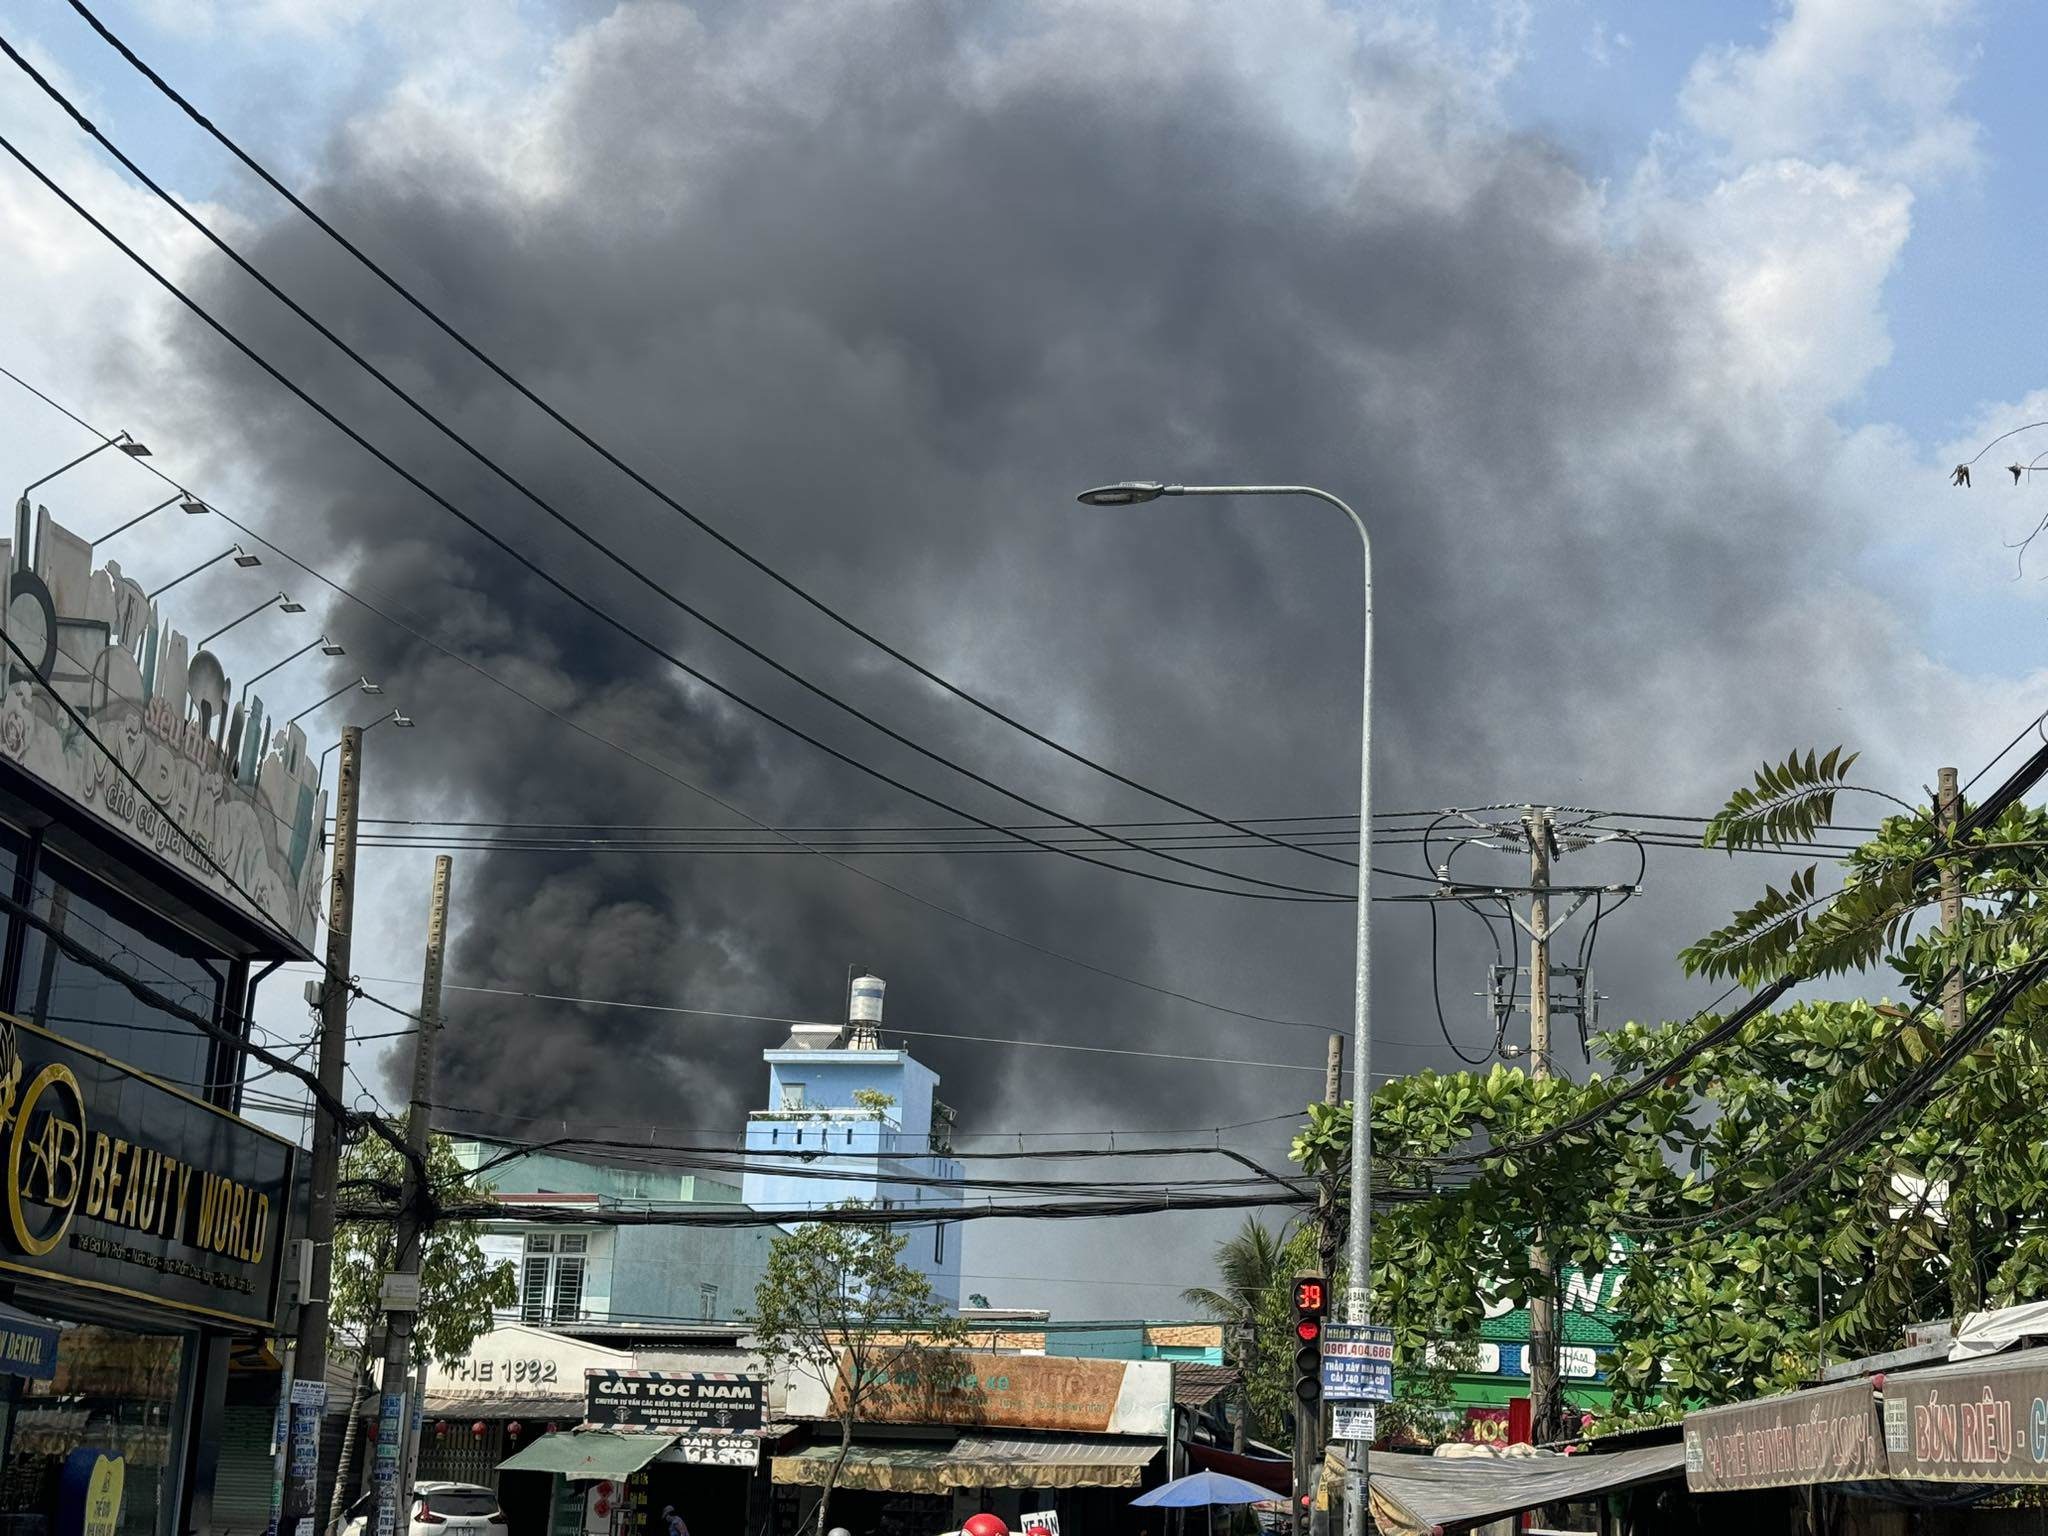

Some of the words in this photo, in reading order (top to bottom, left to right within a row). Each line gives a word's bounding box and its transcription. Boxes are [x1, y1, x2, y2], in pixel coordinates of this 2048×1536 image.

[107, 780, 137, 823] cho
[86, 1131, 193, 1240] BEAUTY
[197, 1170, 270, 1265] WORLD
[1300, 1285, 1320, 1309] 39
[7, 1330, 42, 1365] DENTAL
[646, 1381, 691, 1397] TÓC
[698, 1385, 752, 1399] NAM
[1914, 1389, 1958, 1463] BÚN
[1961, 1385, 2012, 1464] RIÊU
